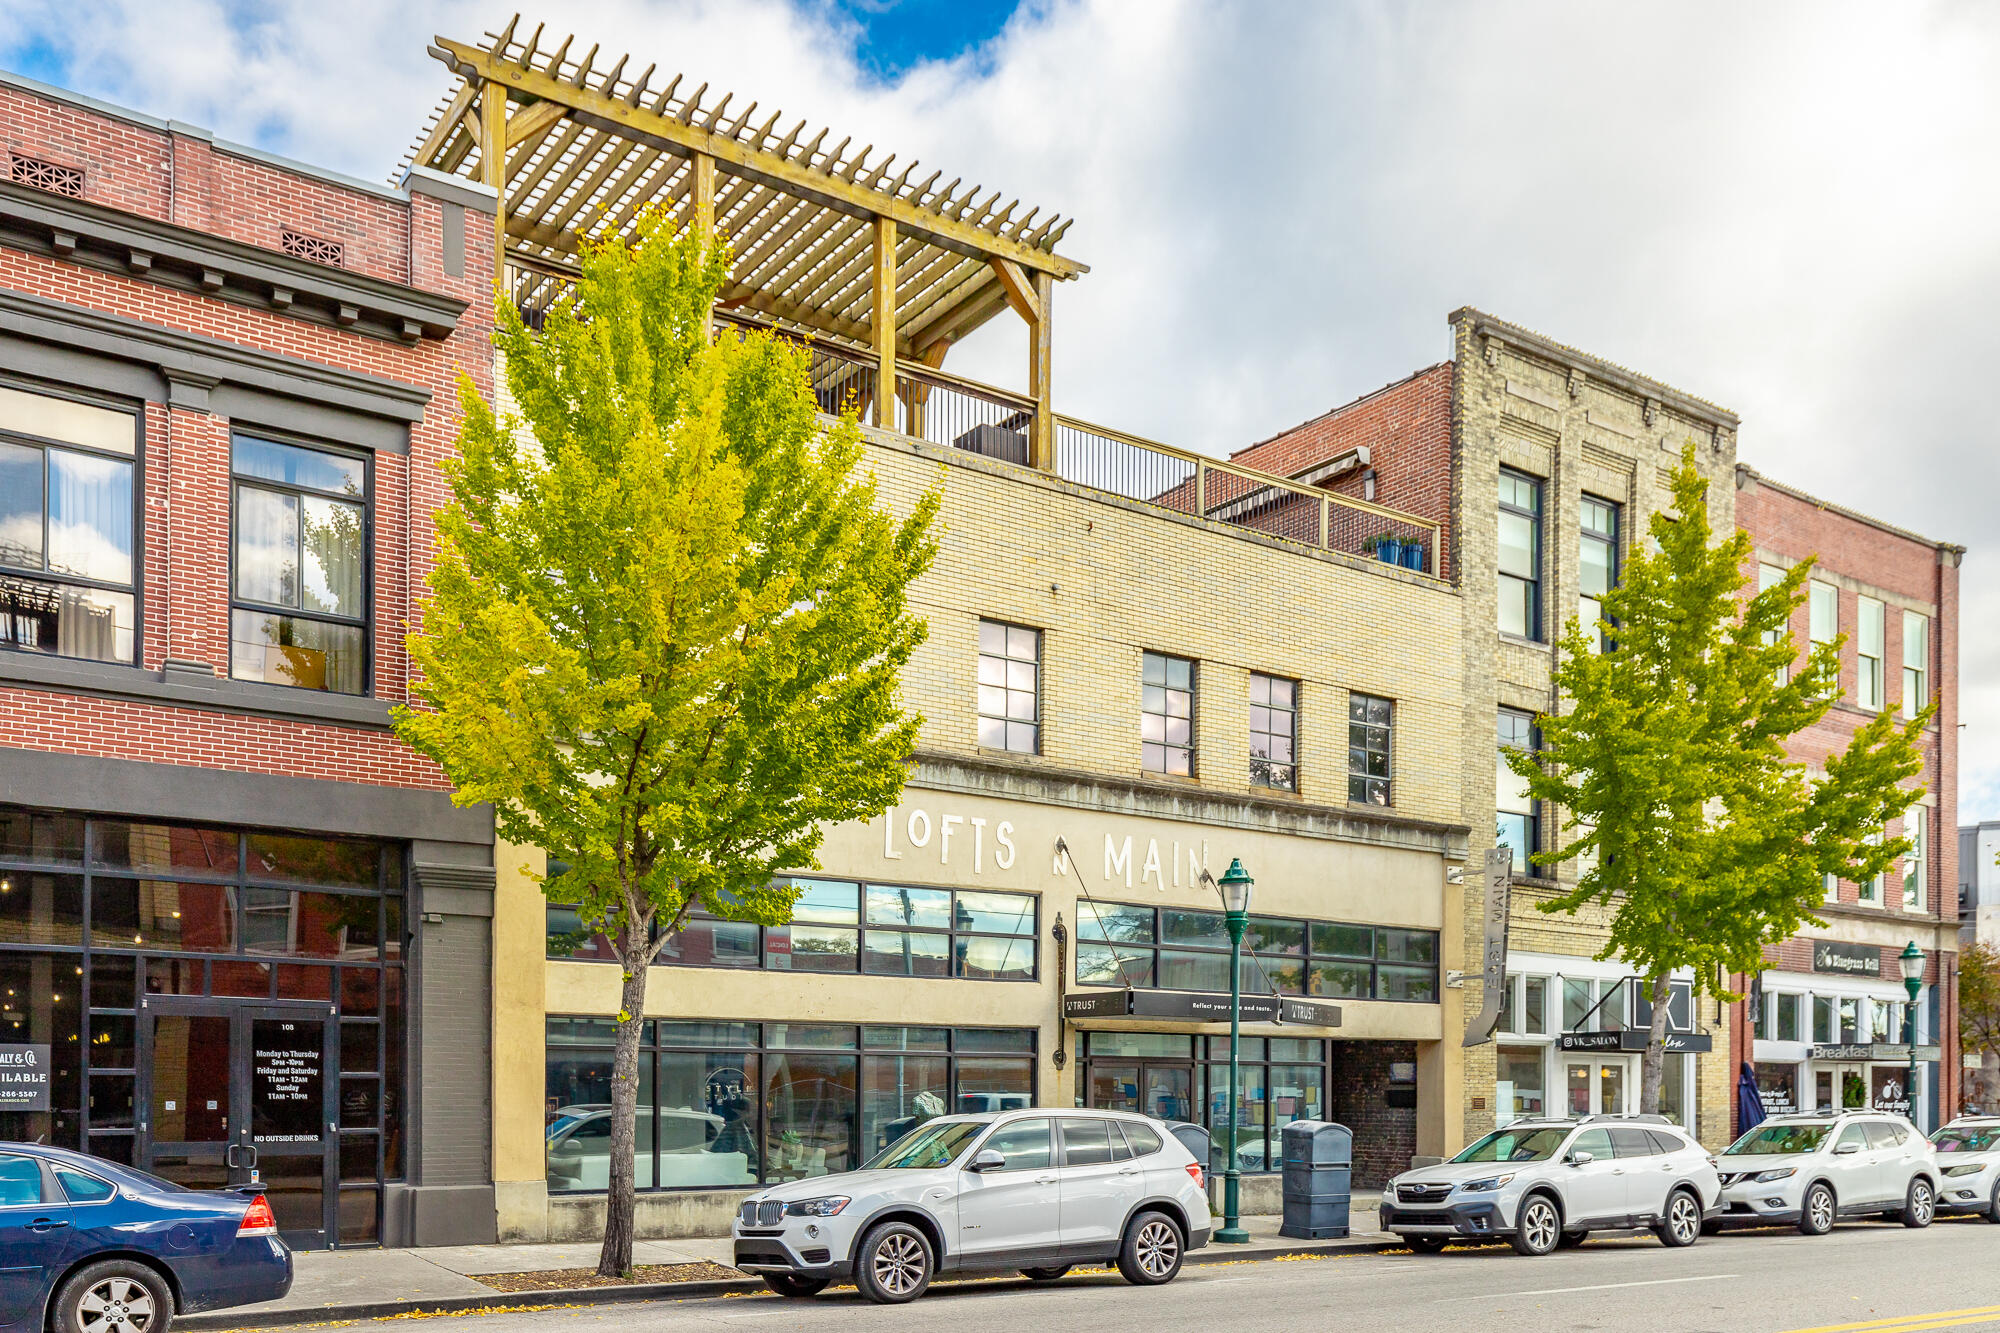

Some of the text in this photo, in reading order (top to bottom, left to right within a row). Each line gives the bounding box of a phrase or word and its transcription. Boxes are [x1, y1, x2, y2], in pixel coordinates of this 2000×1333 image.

[884, 805, 1016, 874] LOFTS
[1104, 833, 1208, 891] MAIN
[1491, 876, 1505, 924] MAIN
[1487, 938, 1500, 989] EAST
[1665, 1034, 1685, 1048] lon
[256, 1050, 281, 1058] Monday
[290, 1050, 319, 1059] Thursday
[1813, 1045, 1873, 1059] Breakfast
[15, 1053, 24, 1064] &
[256, 1067, 318, 1076] Friday and Saturday
[276, 1084, 299, 1093] Sunday
[294, 1134, 319, 1142] DRINKS
